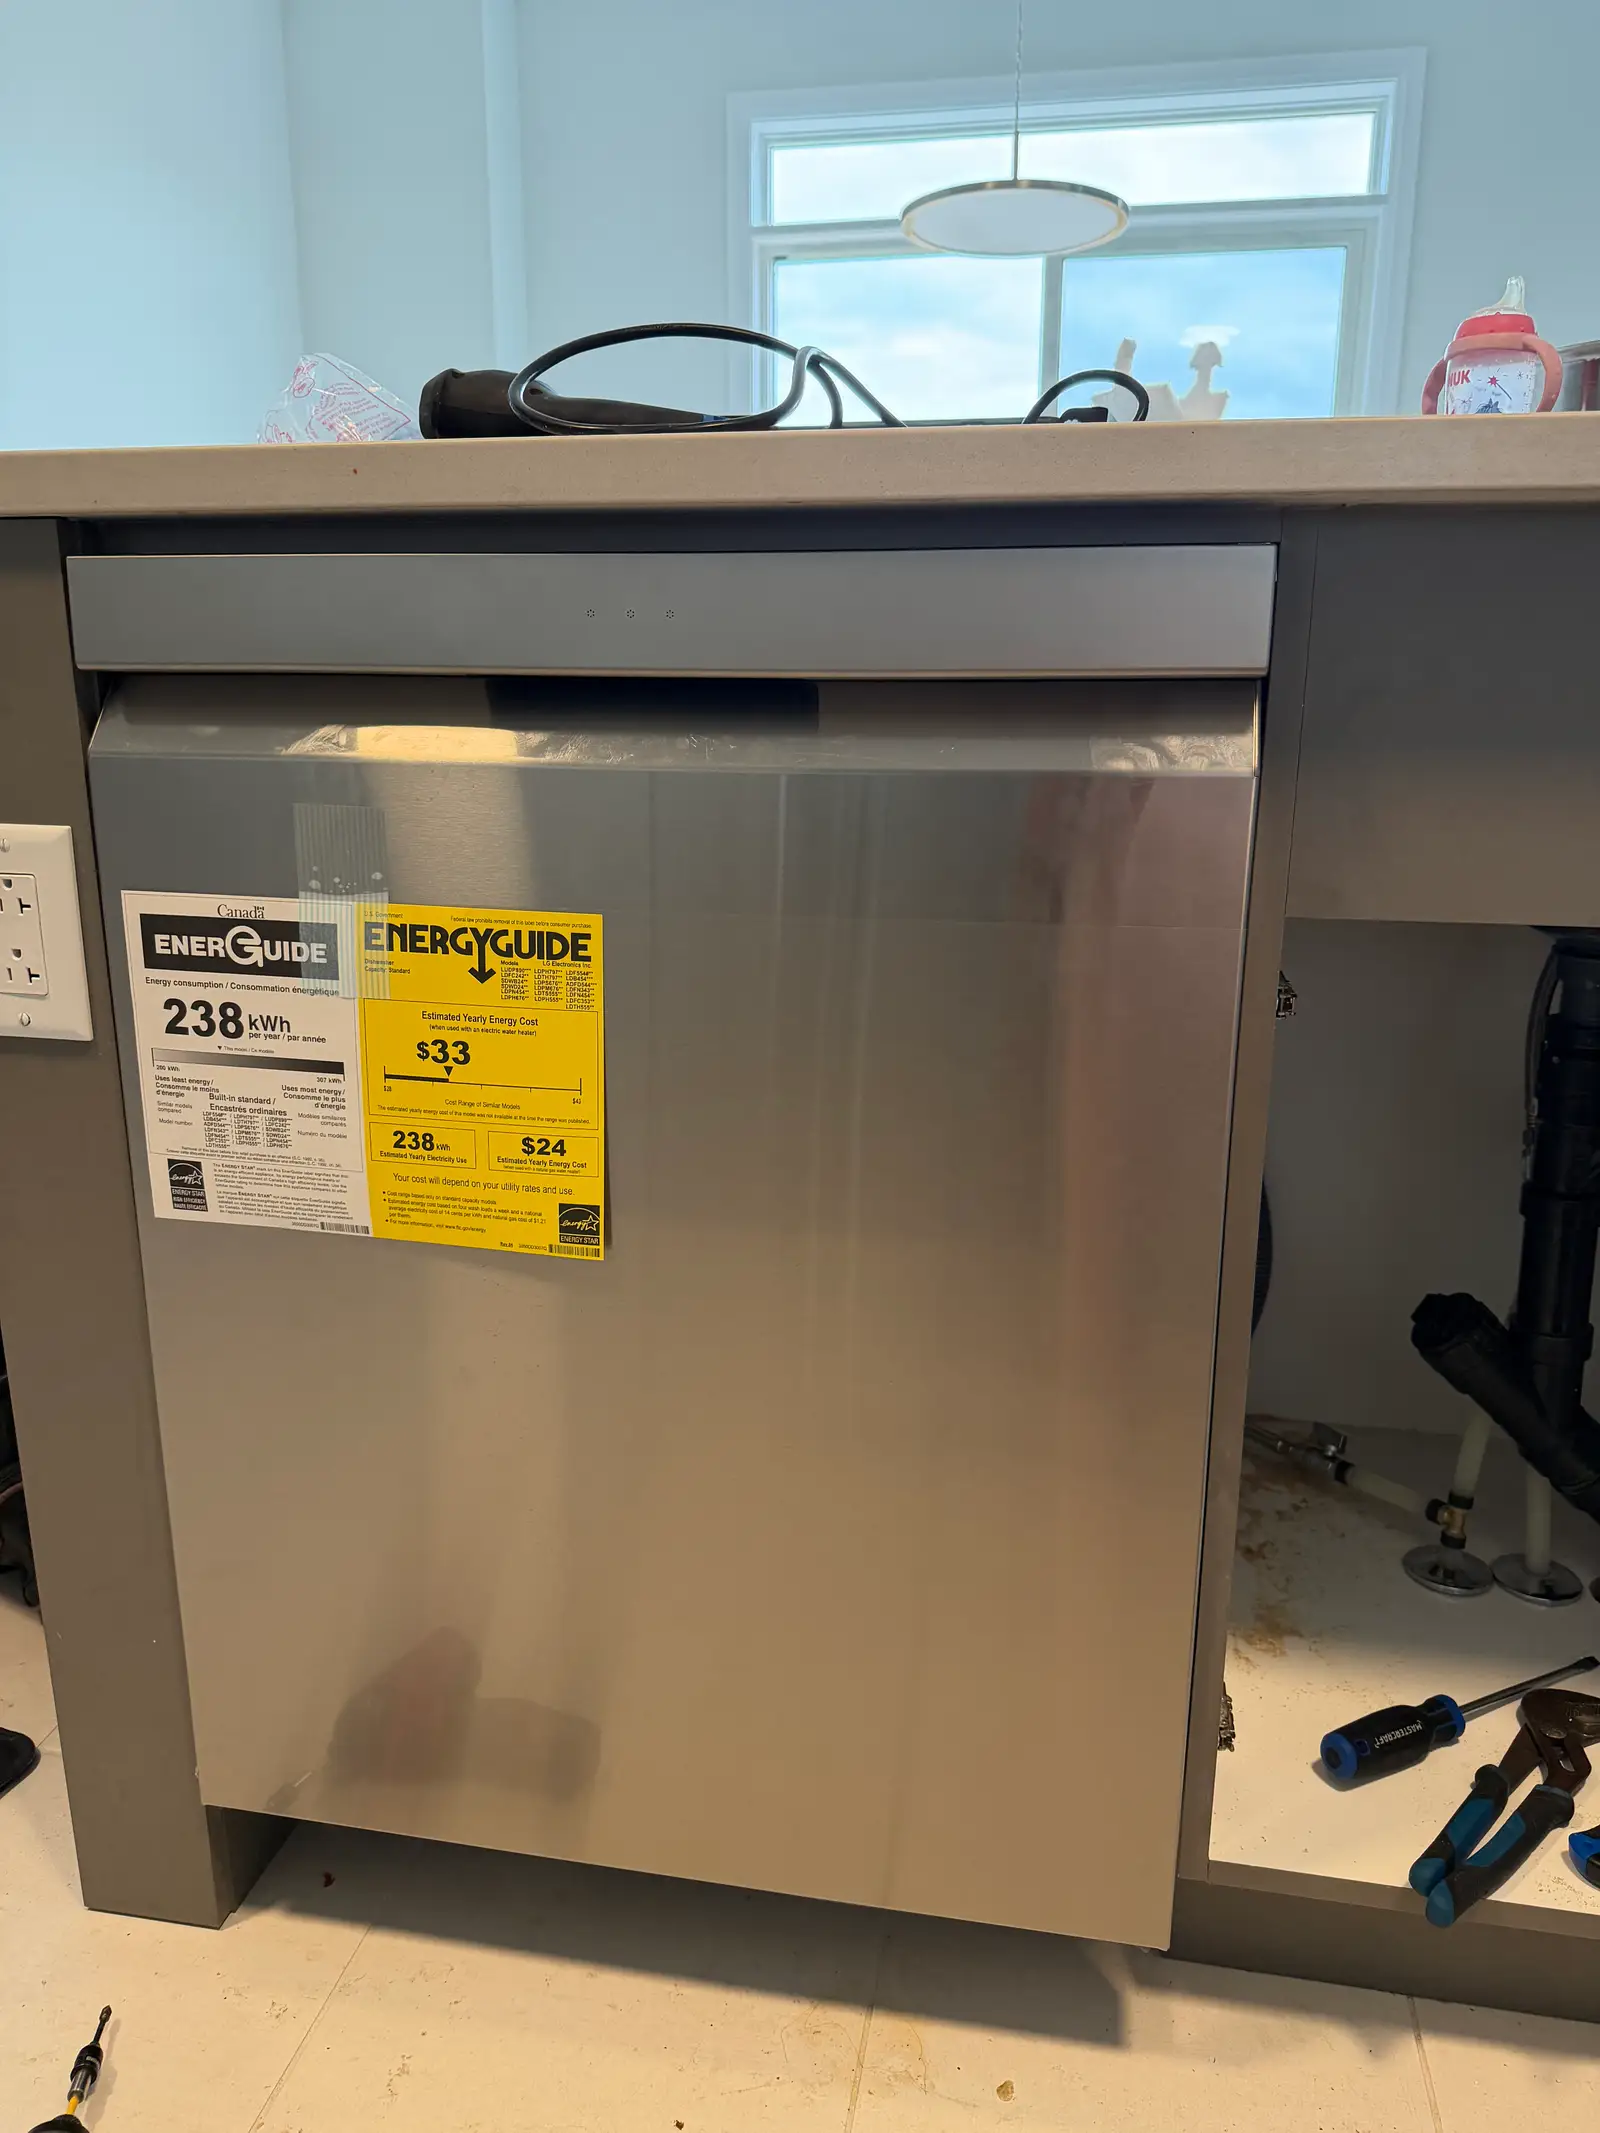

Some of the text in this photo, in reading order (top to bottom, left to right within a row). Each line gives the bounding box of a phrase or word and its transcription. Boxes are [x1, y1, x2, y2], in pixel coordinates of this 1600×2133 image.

[217, 904, 265, 919] Canada
[364, 921, 592, 975] ENERGYGUIDE
[146, 977, 171, 987] Energy
[173, 980, 223, 989] consumption
[230, 982, 289, 993] Consommation
[292, 986, 339, 997] énergétique
[163, 998, 290, 1039] 238 kWh
[422, 1011, 539, 1027] Estimated Yearly Energy Cost
[429, 1024, 445, 1032] (when
[518, 1029, 537, 1037] heater)
[416, 1039, 471, 1065] $33
[155, 1082, 191, 1090] Consomme
[156, 1090, 185, 1098] d'énergie
[209, 1093, 235, 1102] Built-in
[238, 1095, 273, 1104] standard
[283, 1092, 321, 1101] Consomme
[210, 1103, 287, 1115] Encastrés ordinaires
[458, 1100, 474, 1108] Range
[393, 1131, 434, 1151] 238
[521, 1136, 567, 1156] $24
[380, 1151, 407, 1159] Estimated
[408, 1153, 425, 1162] Yearly
[427, 1154, 455, 1164] Electricity
[497, 1156, 527, 1164] Estimated
[528, 1158, 547, 1167] Yearly
[549, 1159, 570, 1169] Energy
[393, 1173, 410, 1183] Your
[411, 1175, 427, 1184] cost
[429, 1176, 440, 1185] will
[442, 1177, 469, 1188] depend
[482, 1182, 499, 1190] your
[501, 1181, 519, 1193] utility
[522, 1183, 540, 1192] rates
[542, 1185, 556, 1194] and
[559, 1187, 575, 1195] use.
[583, 1237, 599, 1245] STAR
[1374, 1721, 1422, 1747] MASTERCRAFT
